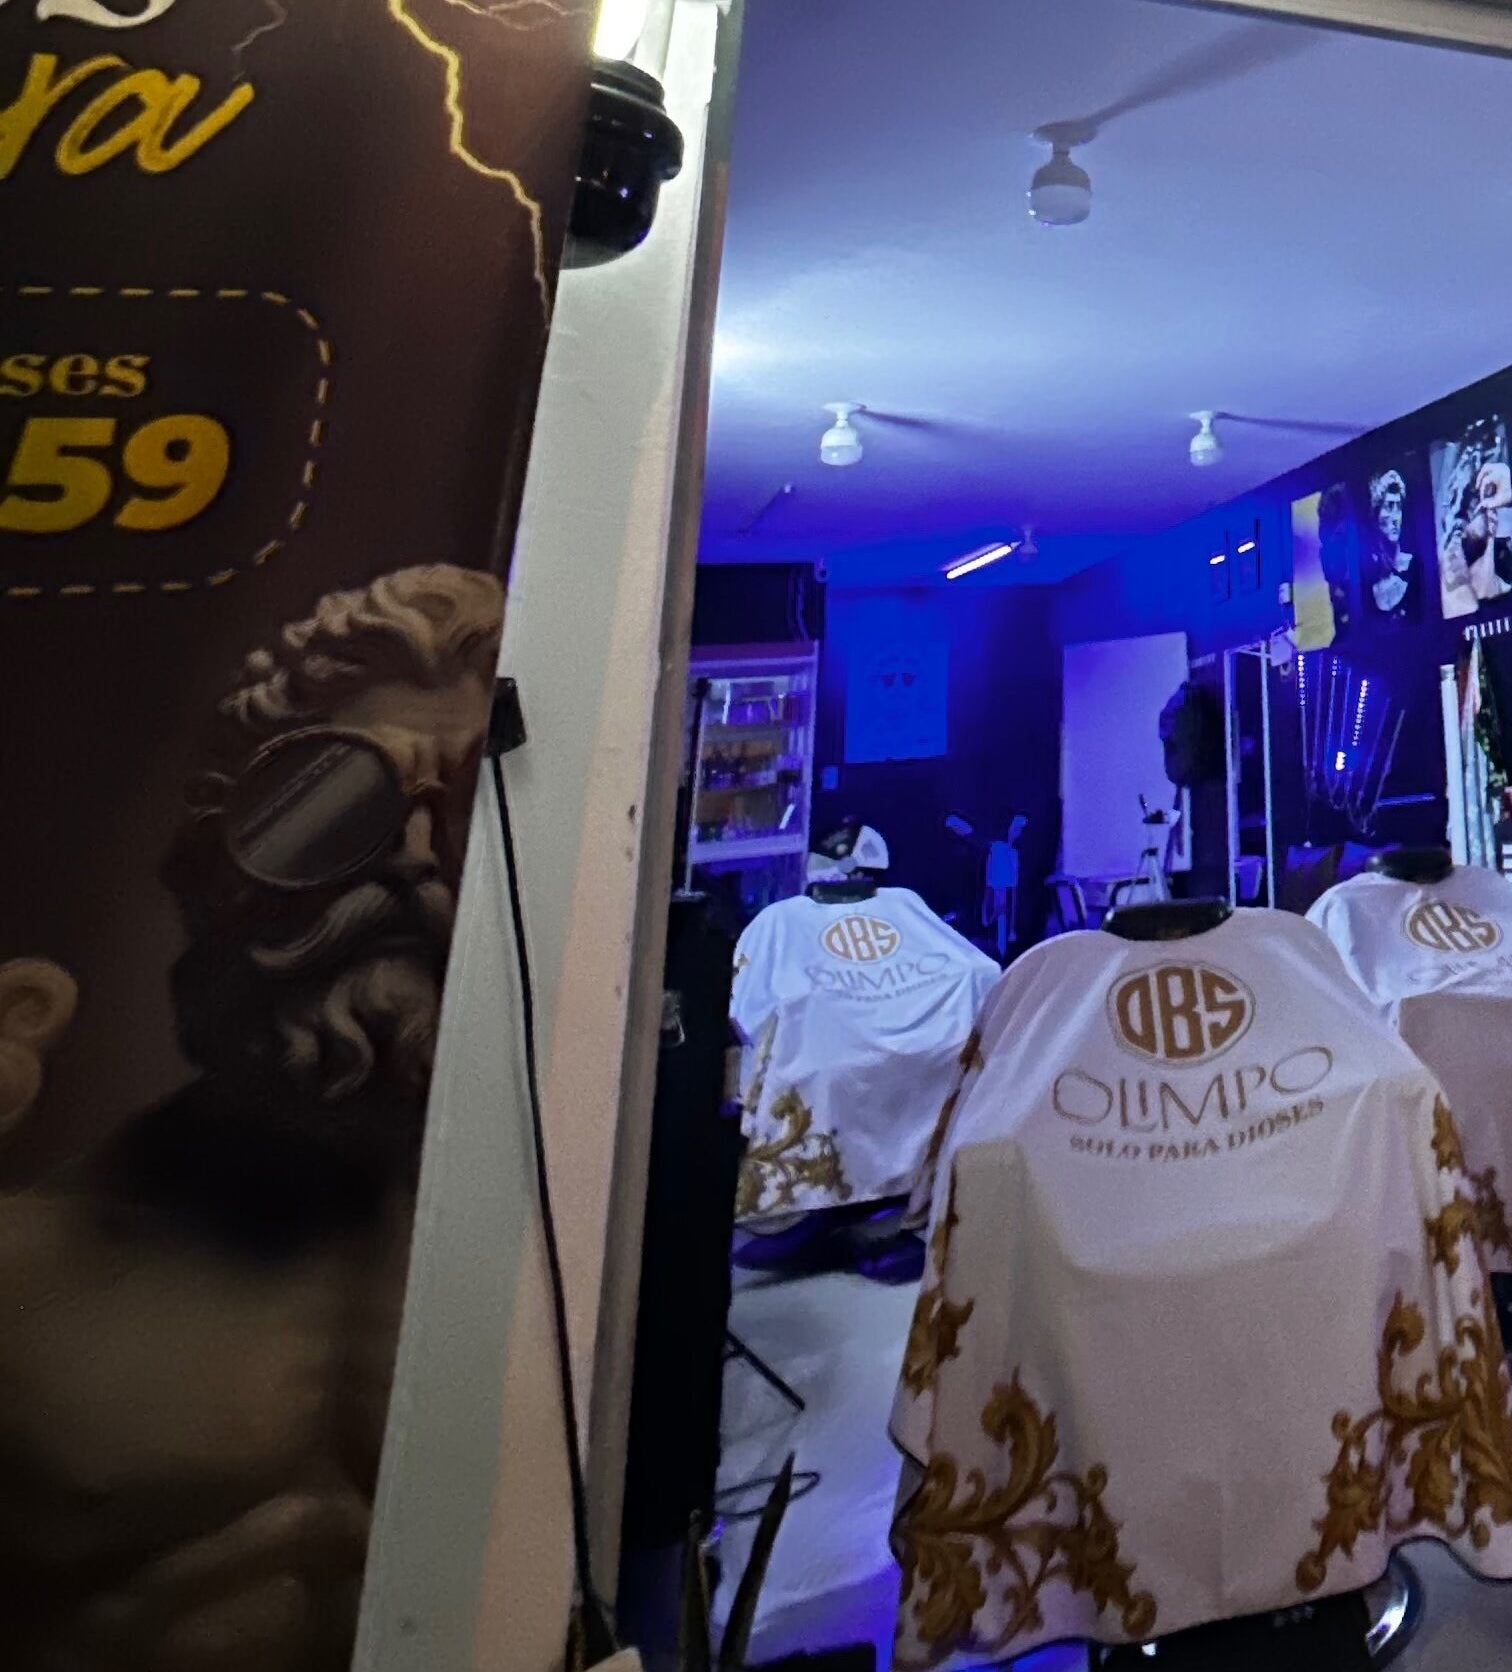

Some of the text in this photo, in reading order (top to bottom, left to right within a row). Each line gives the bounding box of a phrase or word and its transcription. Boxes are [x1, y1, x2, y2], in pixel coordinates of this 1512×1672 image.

[0, 413, 231, 534] 59
[1115, 966, 1247, 1060] OBS
[1053, 1046, 1333, 1133] OLIMPO
